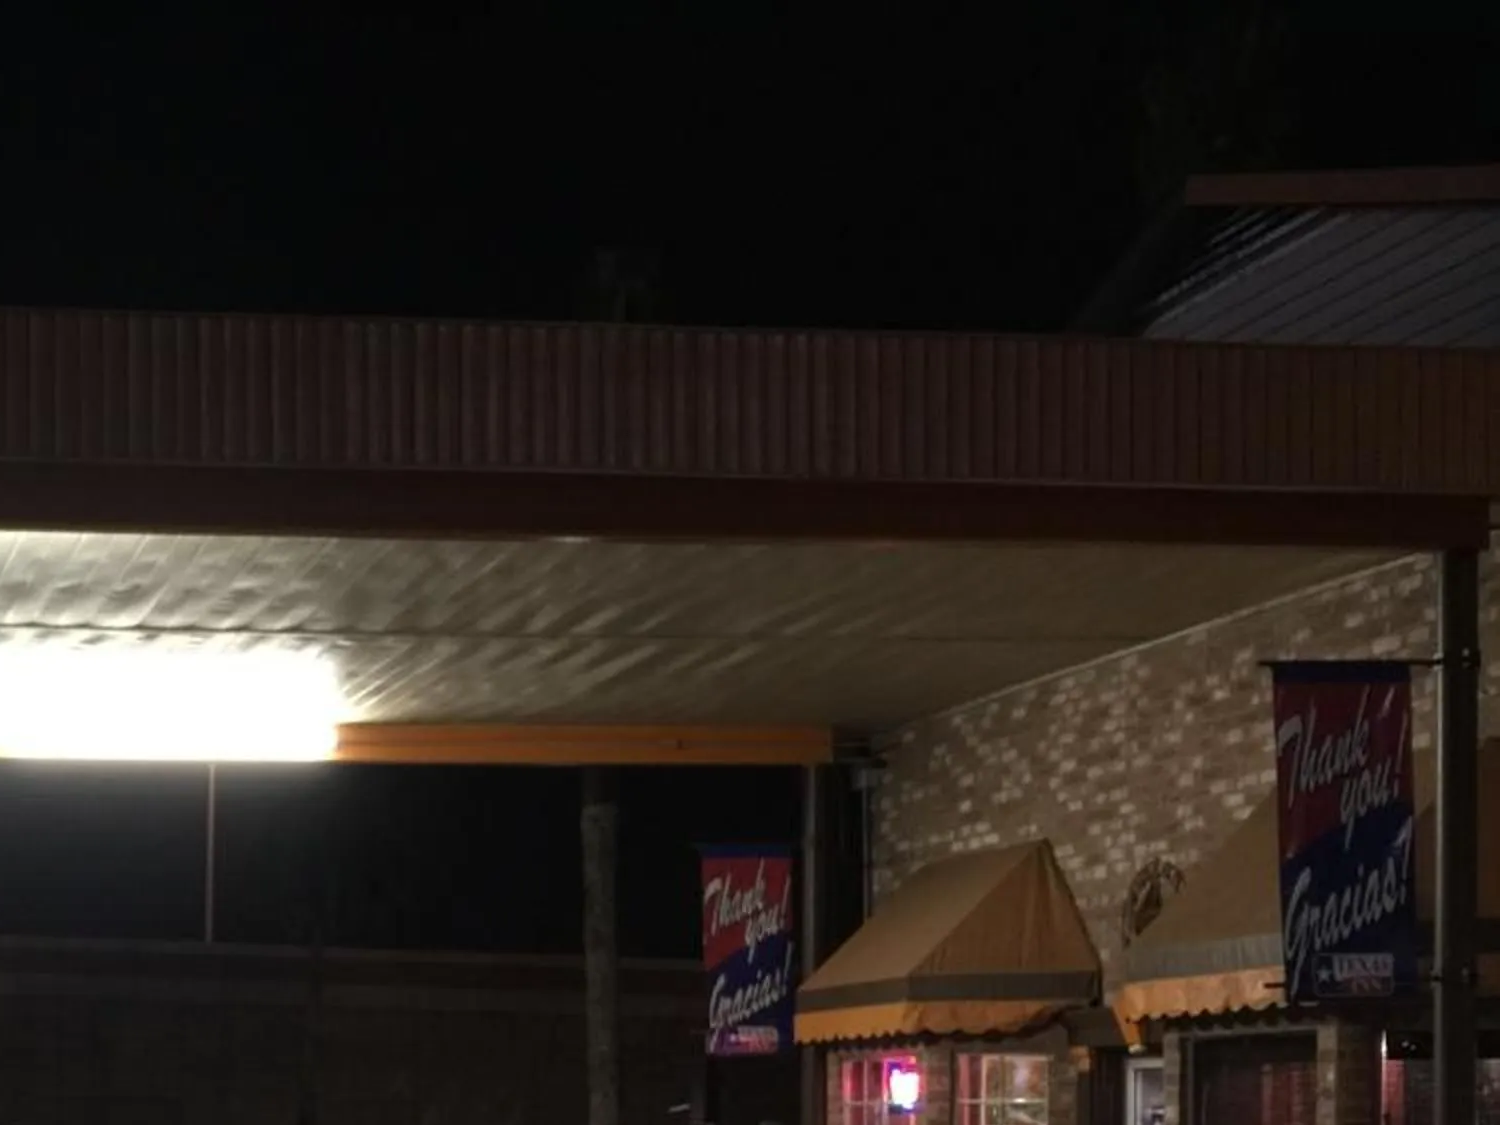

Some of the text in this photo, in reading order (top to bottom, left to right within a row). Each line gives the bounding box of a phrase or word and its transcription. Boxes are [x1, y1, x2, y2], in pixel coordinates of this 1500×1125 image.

[1279, 683, 1371, 809] Thank
[1341, 710, 1408, 852] you!
[704, 856, 766, 936] Thank
[745, 874, 791, 964] you!
[1284, 815, 1412, 1001] Gracias!
[708, 941, 794, 1053] Gracias!
